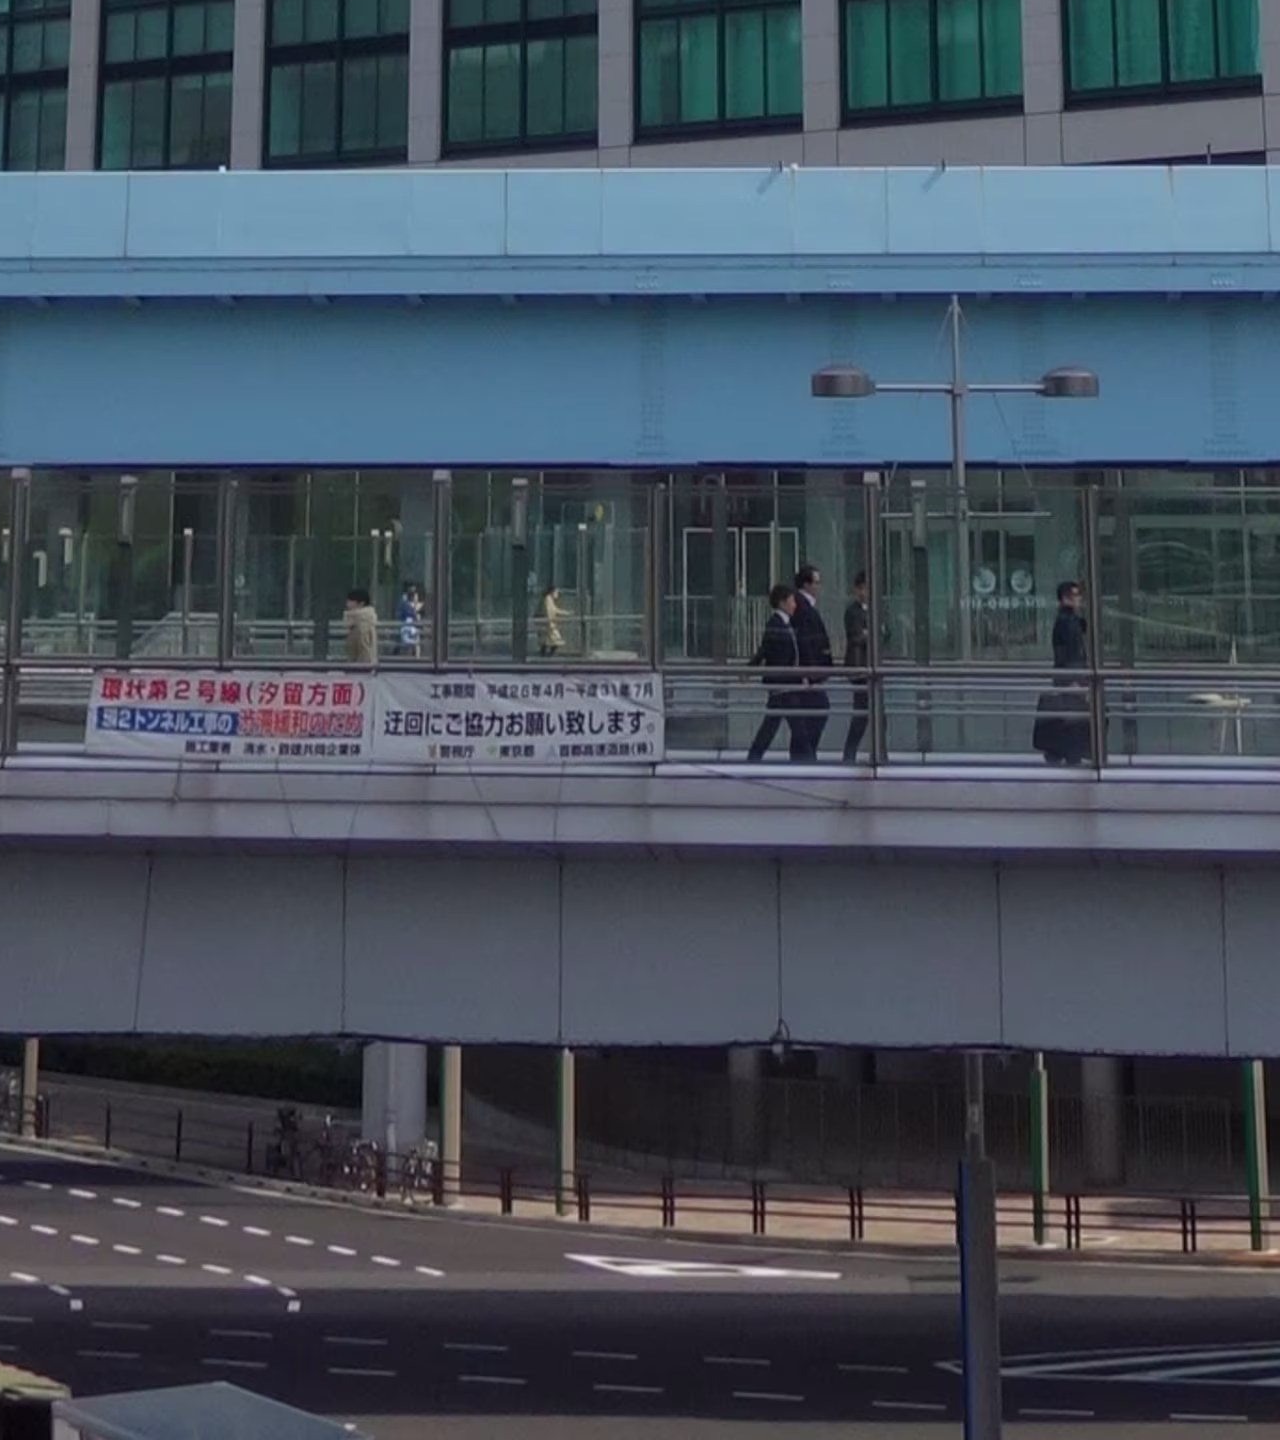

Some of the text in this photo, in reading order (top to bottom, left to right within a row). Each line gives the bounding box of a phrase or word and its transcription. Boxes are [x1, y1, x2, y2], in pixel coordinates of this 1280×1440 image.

[383, 710, 656, 738] 迂回にご協力お願い致します。
